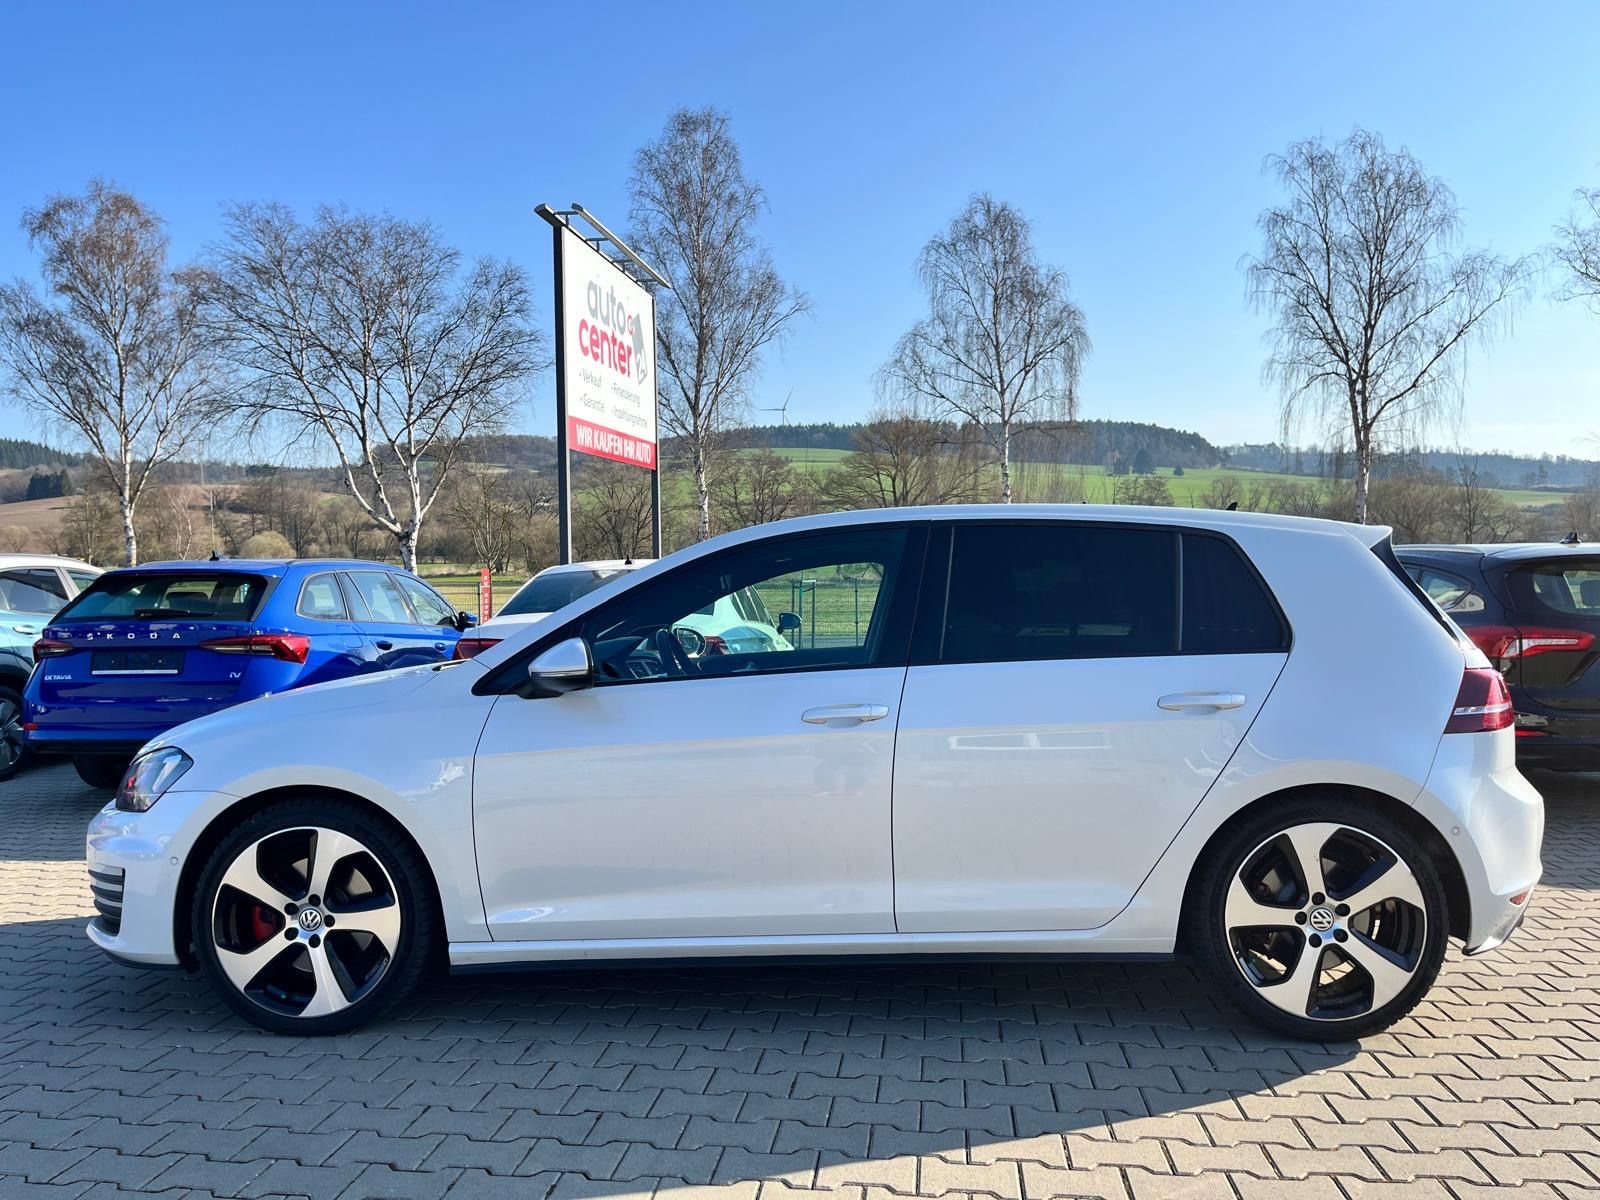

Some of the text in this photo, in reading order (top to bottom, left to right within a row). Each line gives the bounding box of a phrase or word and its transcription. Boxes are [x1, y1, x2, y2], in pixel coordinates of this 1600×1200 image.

[587, 280, 626, 335] auto
[579, 318, 632, 377] center
[576, 424, 652, 465] WIR KAUFEN IHR AUTO
